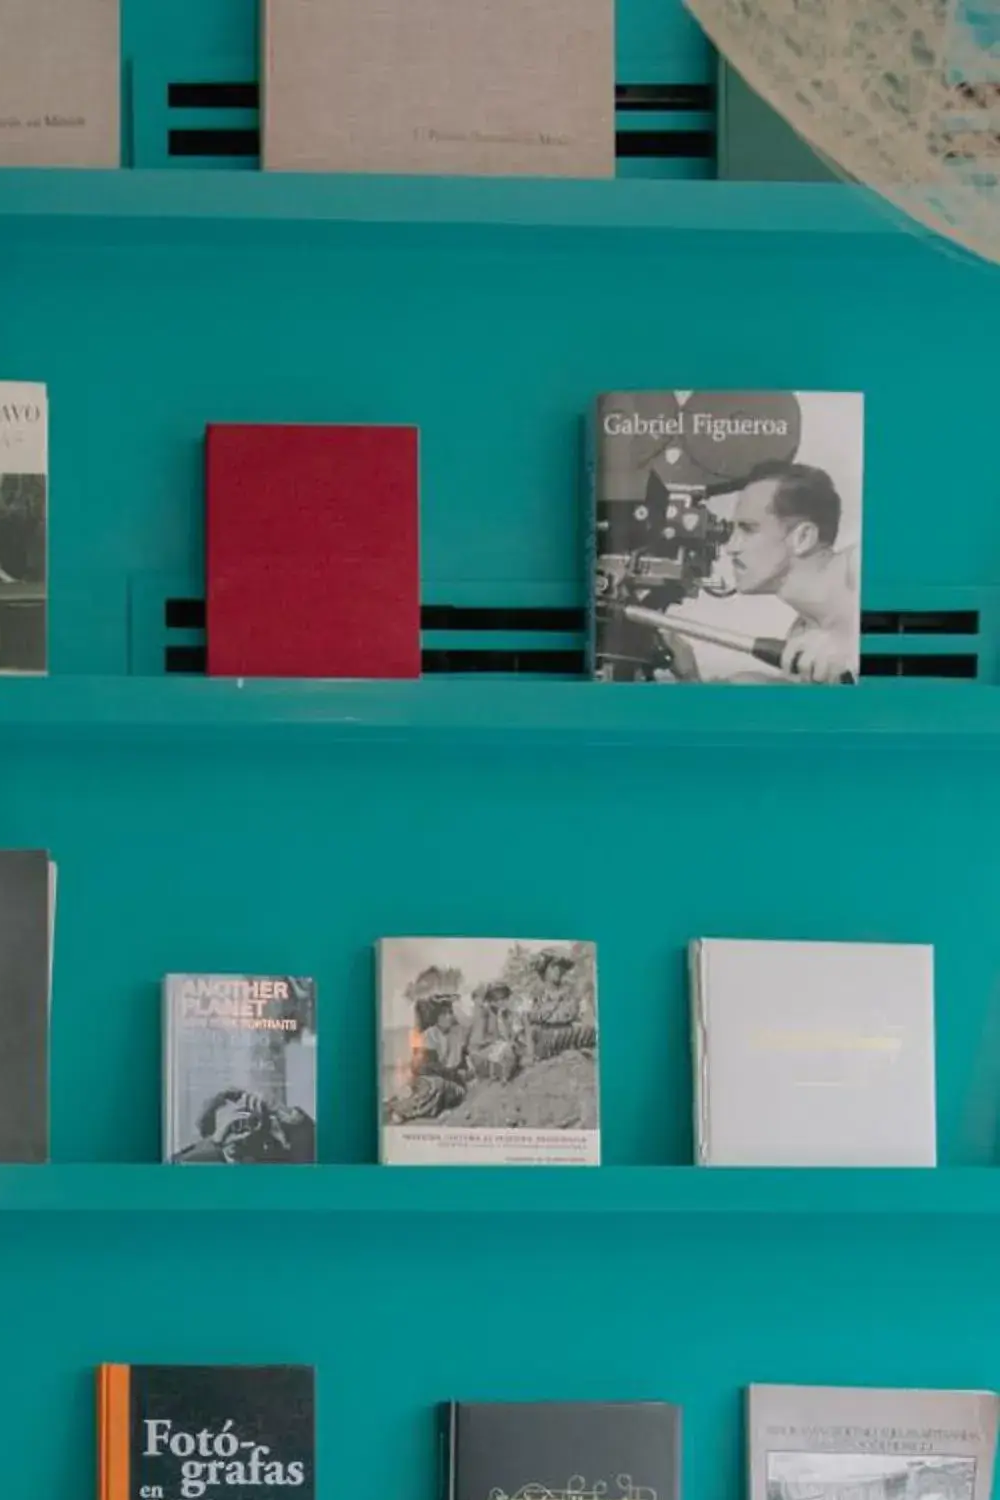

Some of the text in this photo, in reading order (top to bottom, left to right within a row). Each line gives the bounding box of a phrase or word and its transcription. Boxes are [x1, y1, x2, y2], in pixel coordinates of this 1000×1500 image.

[603, 411, 788, 442] Gabriel Figueroa
[183, 979, 289, 999] ANOTHER
[183, 998, 268, 1017] PLANET
[142, 1419, 256, 1457] Fotó-
[180, 1445, 305, 1498] grafas
[139, 1485, 164, 1498] en
